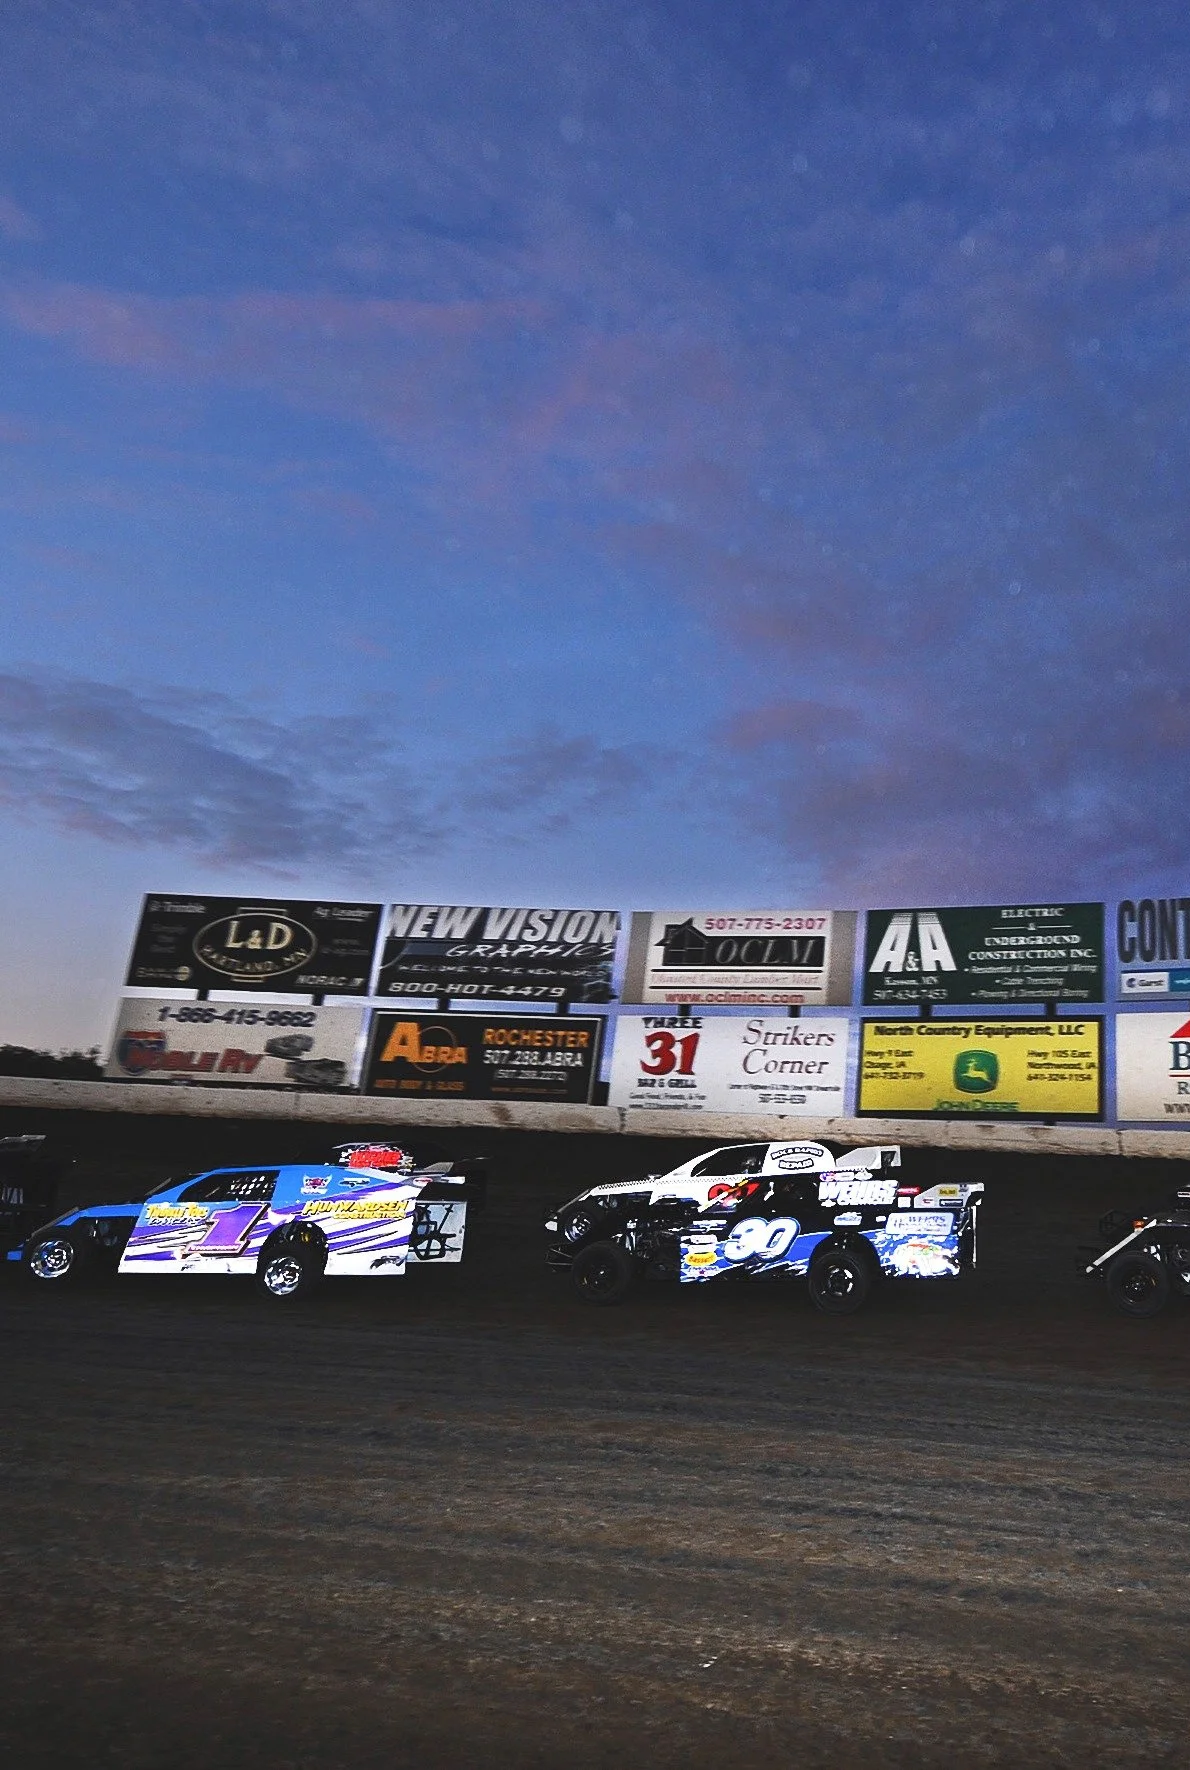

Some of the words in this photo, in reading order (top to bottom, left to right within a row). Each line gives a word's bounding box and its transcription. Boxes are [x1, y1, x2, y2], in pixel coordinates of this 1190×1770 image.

[1001, 908, 1064, 918] ELECTRIC
[386, 905, 482, 939] NEW
[482, 908, 618, 943] VISION
[705, 917, 826, 930] 507-775-2307
[225, 920, 294, 950] L&D
[984, 934, 1081, 946] UNDERGROUND
[446, 943, 617, 958] GRAPHICS
[968, 949, 1066, 961] CONSTRUCTION
[388, 982, 566, 998] 800-HOT-4479
[483, 1028, 590, 1048] ROCHESTER
[742, 1019, 836, 1047] Strikers
[874, 1025, 913, 1036] North
[916, 1025, 971, 1038] Country
[974, 1025, 1054, 1038] Equipment,
[1058, 1024, 1085, 1036] LLC
[380, 1021, 468, 1064] ABRA
[640, 1031, 701, 1076] 31
[742, 1048, 829, 1075] Corner
[190, 1201, 269, 1254] 1
